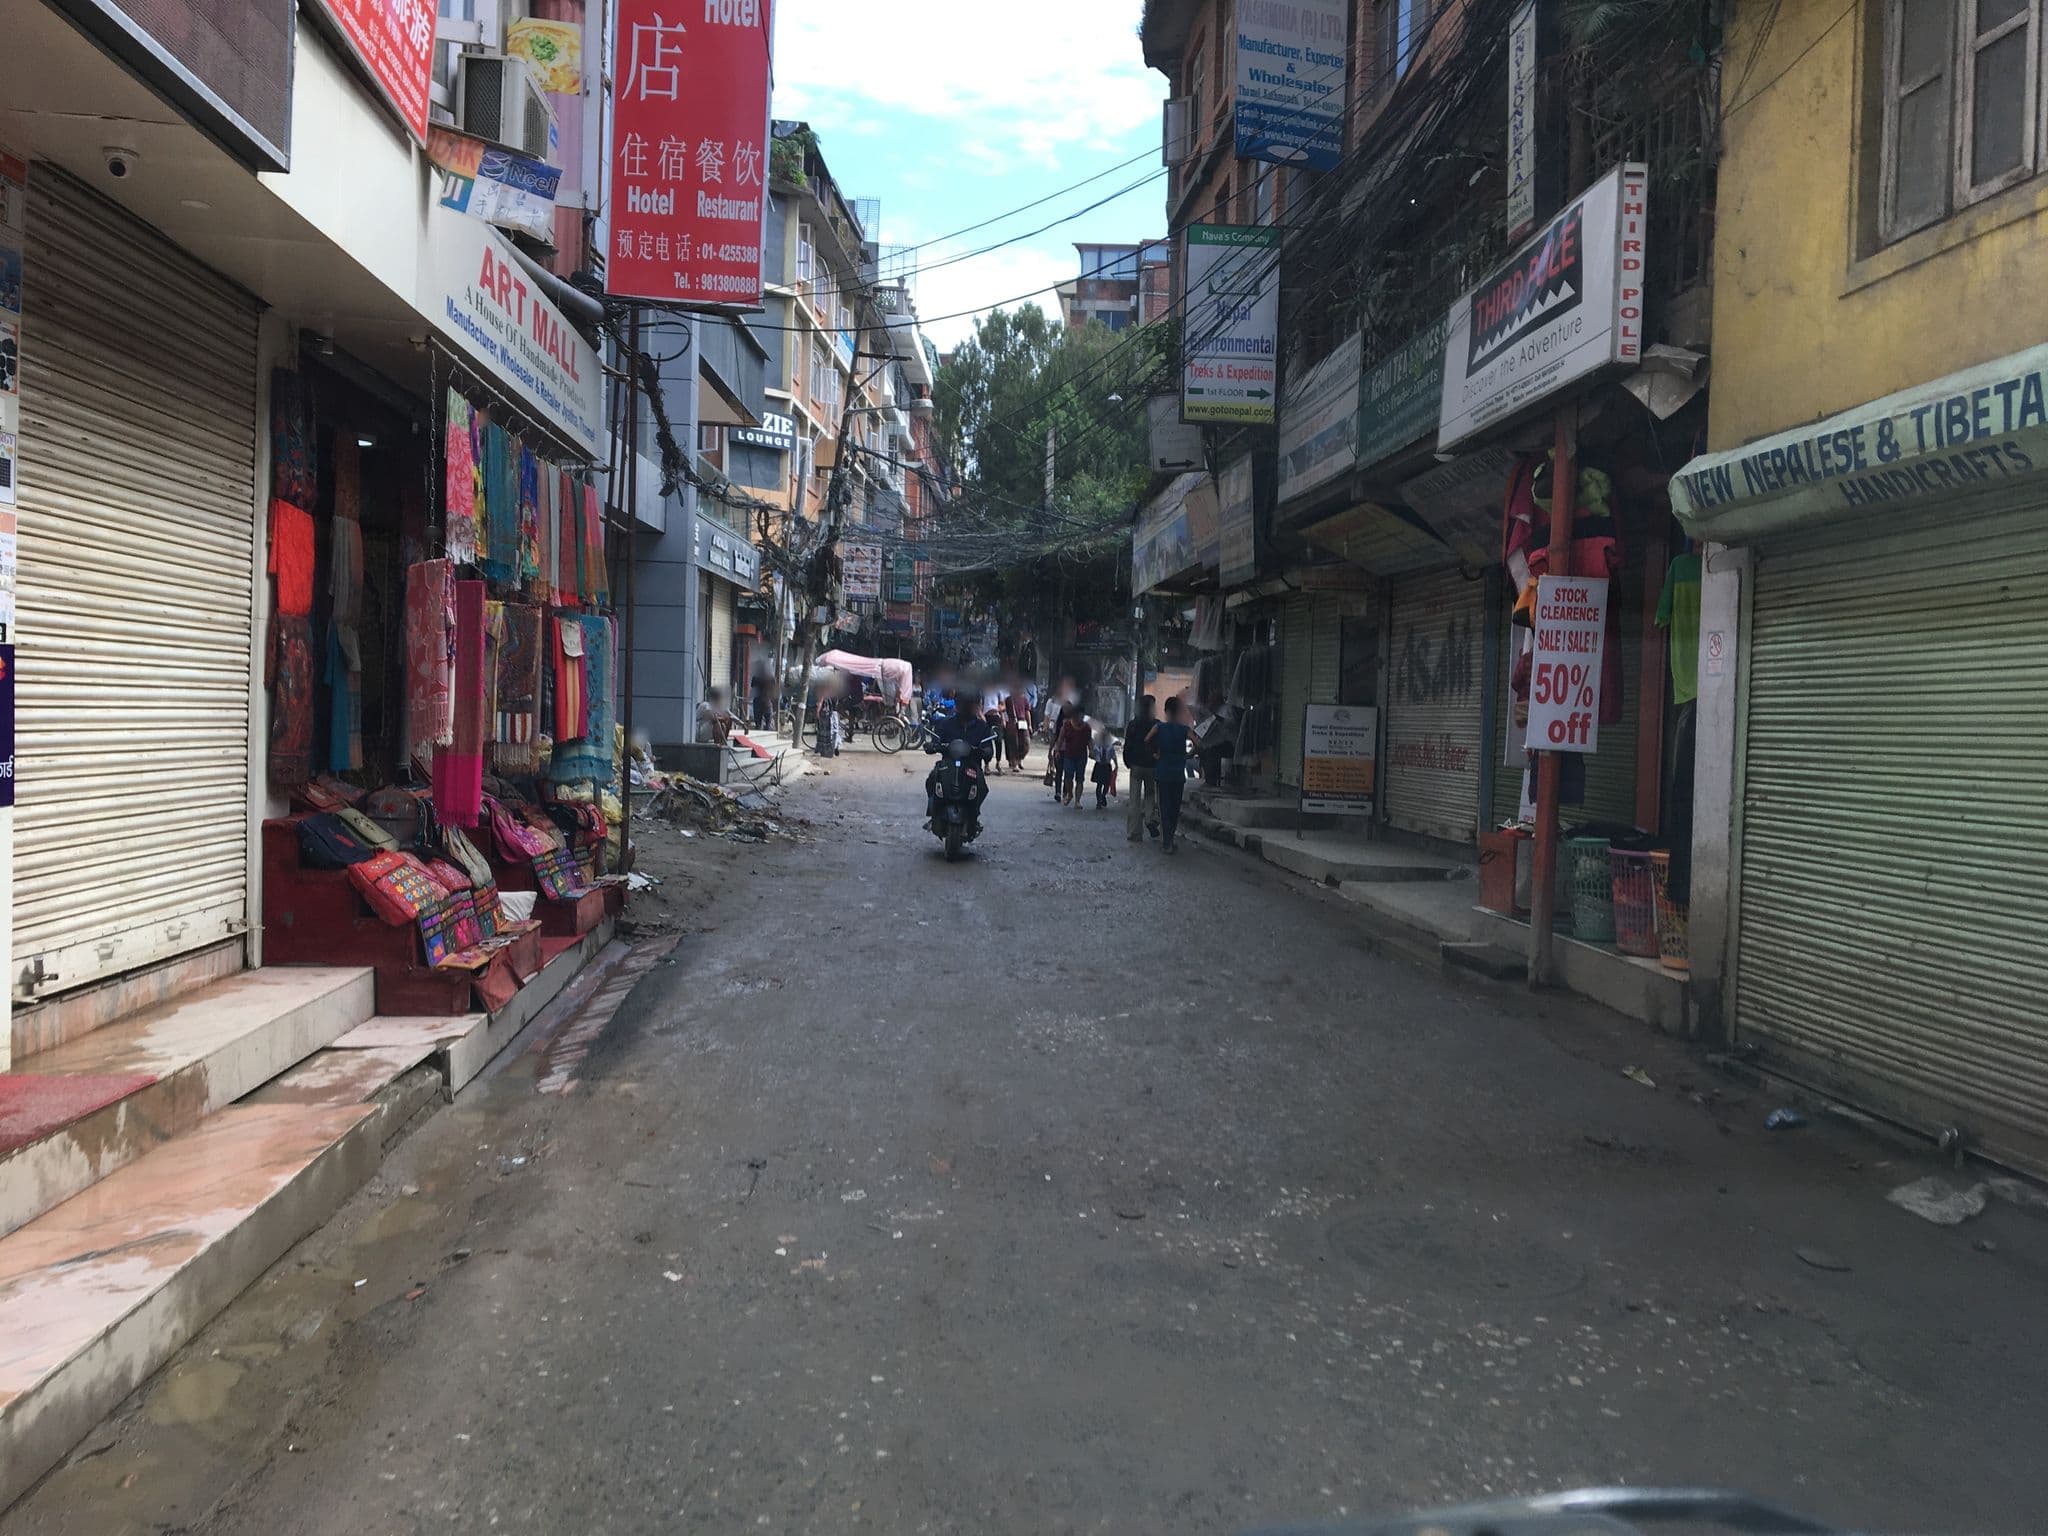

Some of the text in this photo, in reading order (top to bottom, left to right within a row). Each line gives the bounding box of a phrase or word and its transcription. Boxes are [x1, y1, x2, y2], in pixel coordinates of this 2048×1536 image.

[704, 0, 759, 27] Hotel
[621, 12, 686, 101] 店
[1286, 62, 1296, 73] &
[1306, 47, 1344, 69] Exporter
[1249, 67, 1334, 94] Wholesaler
[619, 132, 762, 186] 住宿餐饮
[509, 163, 560, 194] Ncell
[627, 186, 758, 222] Hotel Restaurant
[1622, 184, 1643, 270] THIRD
[617, 229, 691, 261] 预定电话
[674, 272, 691, 290] Tel.
[465, 285, 473, 302] A
[475, 291, 504, 335] House
[505, 323, 519, 348] Of
[479, 245, 580, 384] ART MALL
[1216, 300, 1250, 321] Nepal
[1474, 268, 1524, 336] THIRD
[1620, 288, 1640, 356] POLE
[446, 294, 500, 364] Manufacturer,
[500, 344, 535, 391] Wholesaler
[1190, 331, 1275, 355] Environmental
[1518, 314, 1583, 364] Adventure
[1189, 362, 1274, 382] Treks & Expedition
[738, 431, 791, 448] LOUNGE
[1683, 371, 2048, 510] NEW NEPALESE & TIBETA
[1838, 441, 2034, 506] HANDICRAFTS
[1554, 588, 1588, 603] STOCK
[1540, 606, 1599, 622] CLEARENCE
[1538, 629, 1561, 651] SALE
[1535, 663, 1594, 708] 50%
[1548, 712, 1592, 745] off
